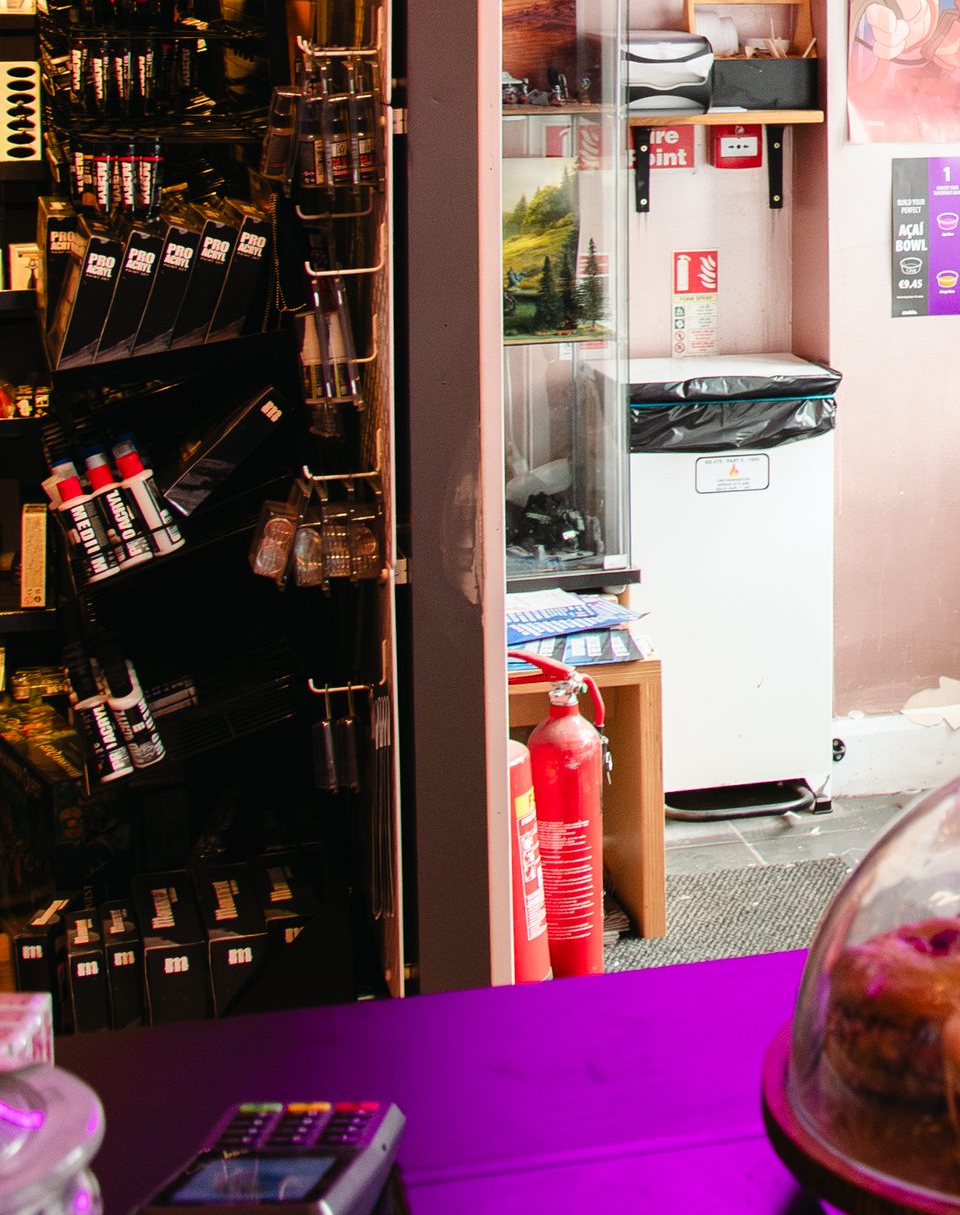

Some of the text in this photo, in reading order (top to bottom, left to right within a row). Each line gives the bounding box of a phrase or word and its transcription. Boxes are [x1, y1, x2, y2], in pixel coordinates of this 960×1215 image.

[943, 166, 951, 182] 1
[50, 241, 71, 251] ACR
[204, 236, 230, 252] PRO
[240, 232, 267, 247] PRO
[896, 238, 928, 252] BOWL
[129, 248, 156, 264] PRO
[167, 243, 194, 258] PRO
[200, 249, 226, 262] ACRYL
[237, 243, 263, 257] ACRYL
[89, 253, 116, 269] PRO
[125, 260, 152, 273] ACRYL
[163, 255, 190, 269] ACRYL
[85, 265, 112, 278] ACRYL
